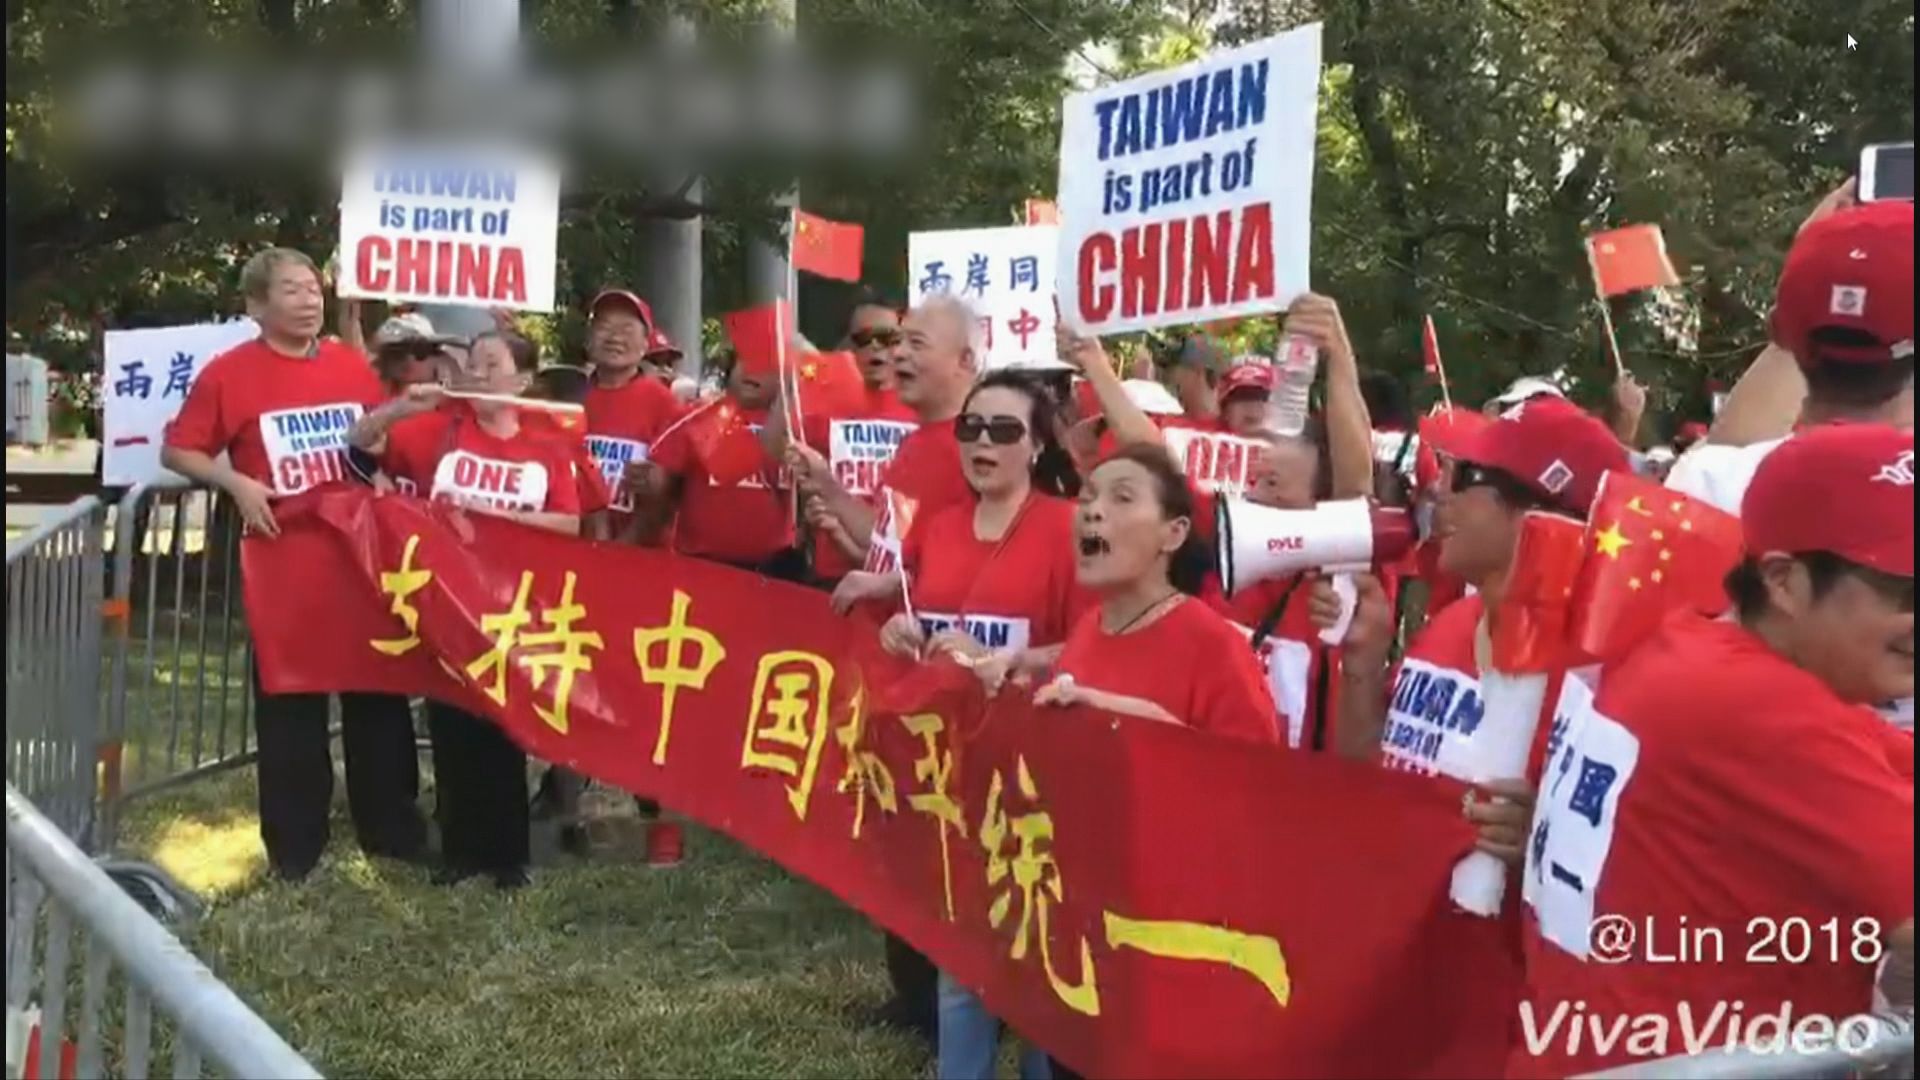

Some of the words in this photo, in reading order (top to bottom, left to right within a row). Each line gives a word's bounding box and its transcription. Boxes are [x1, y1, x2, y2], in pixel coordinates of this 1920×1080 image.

[1094, 57, 1270, 161] TAIWAN
[1102, 169, 1133, 215] is
[1139, 152, 1214, 213] part
[1221, 137, 1258, 192] of
[379, 200, 406, 228] is
[412, 205, 475, 233] part
[481, 208, 510, 236] of
[356, 234, 528, 303] CHINA
[1077, 202, 1276, 324] CHINA
[841, 423, 903, 446] TAIWA
[279, 449, 345, 491] CHI
[453, 455, 523, 494] ONE
